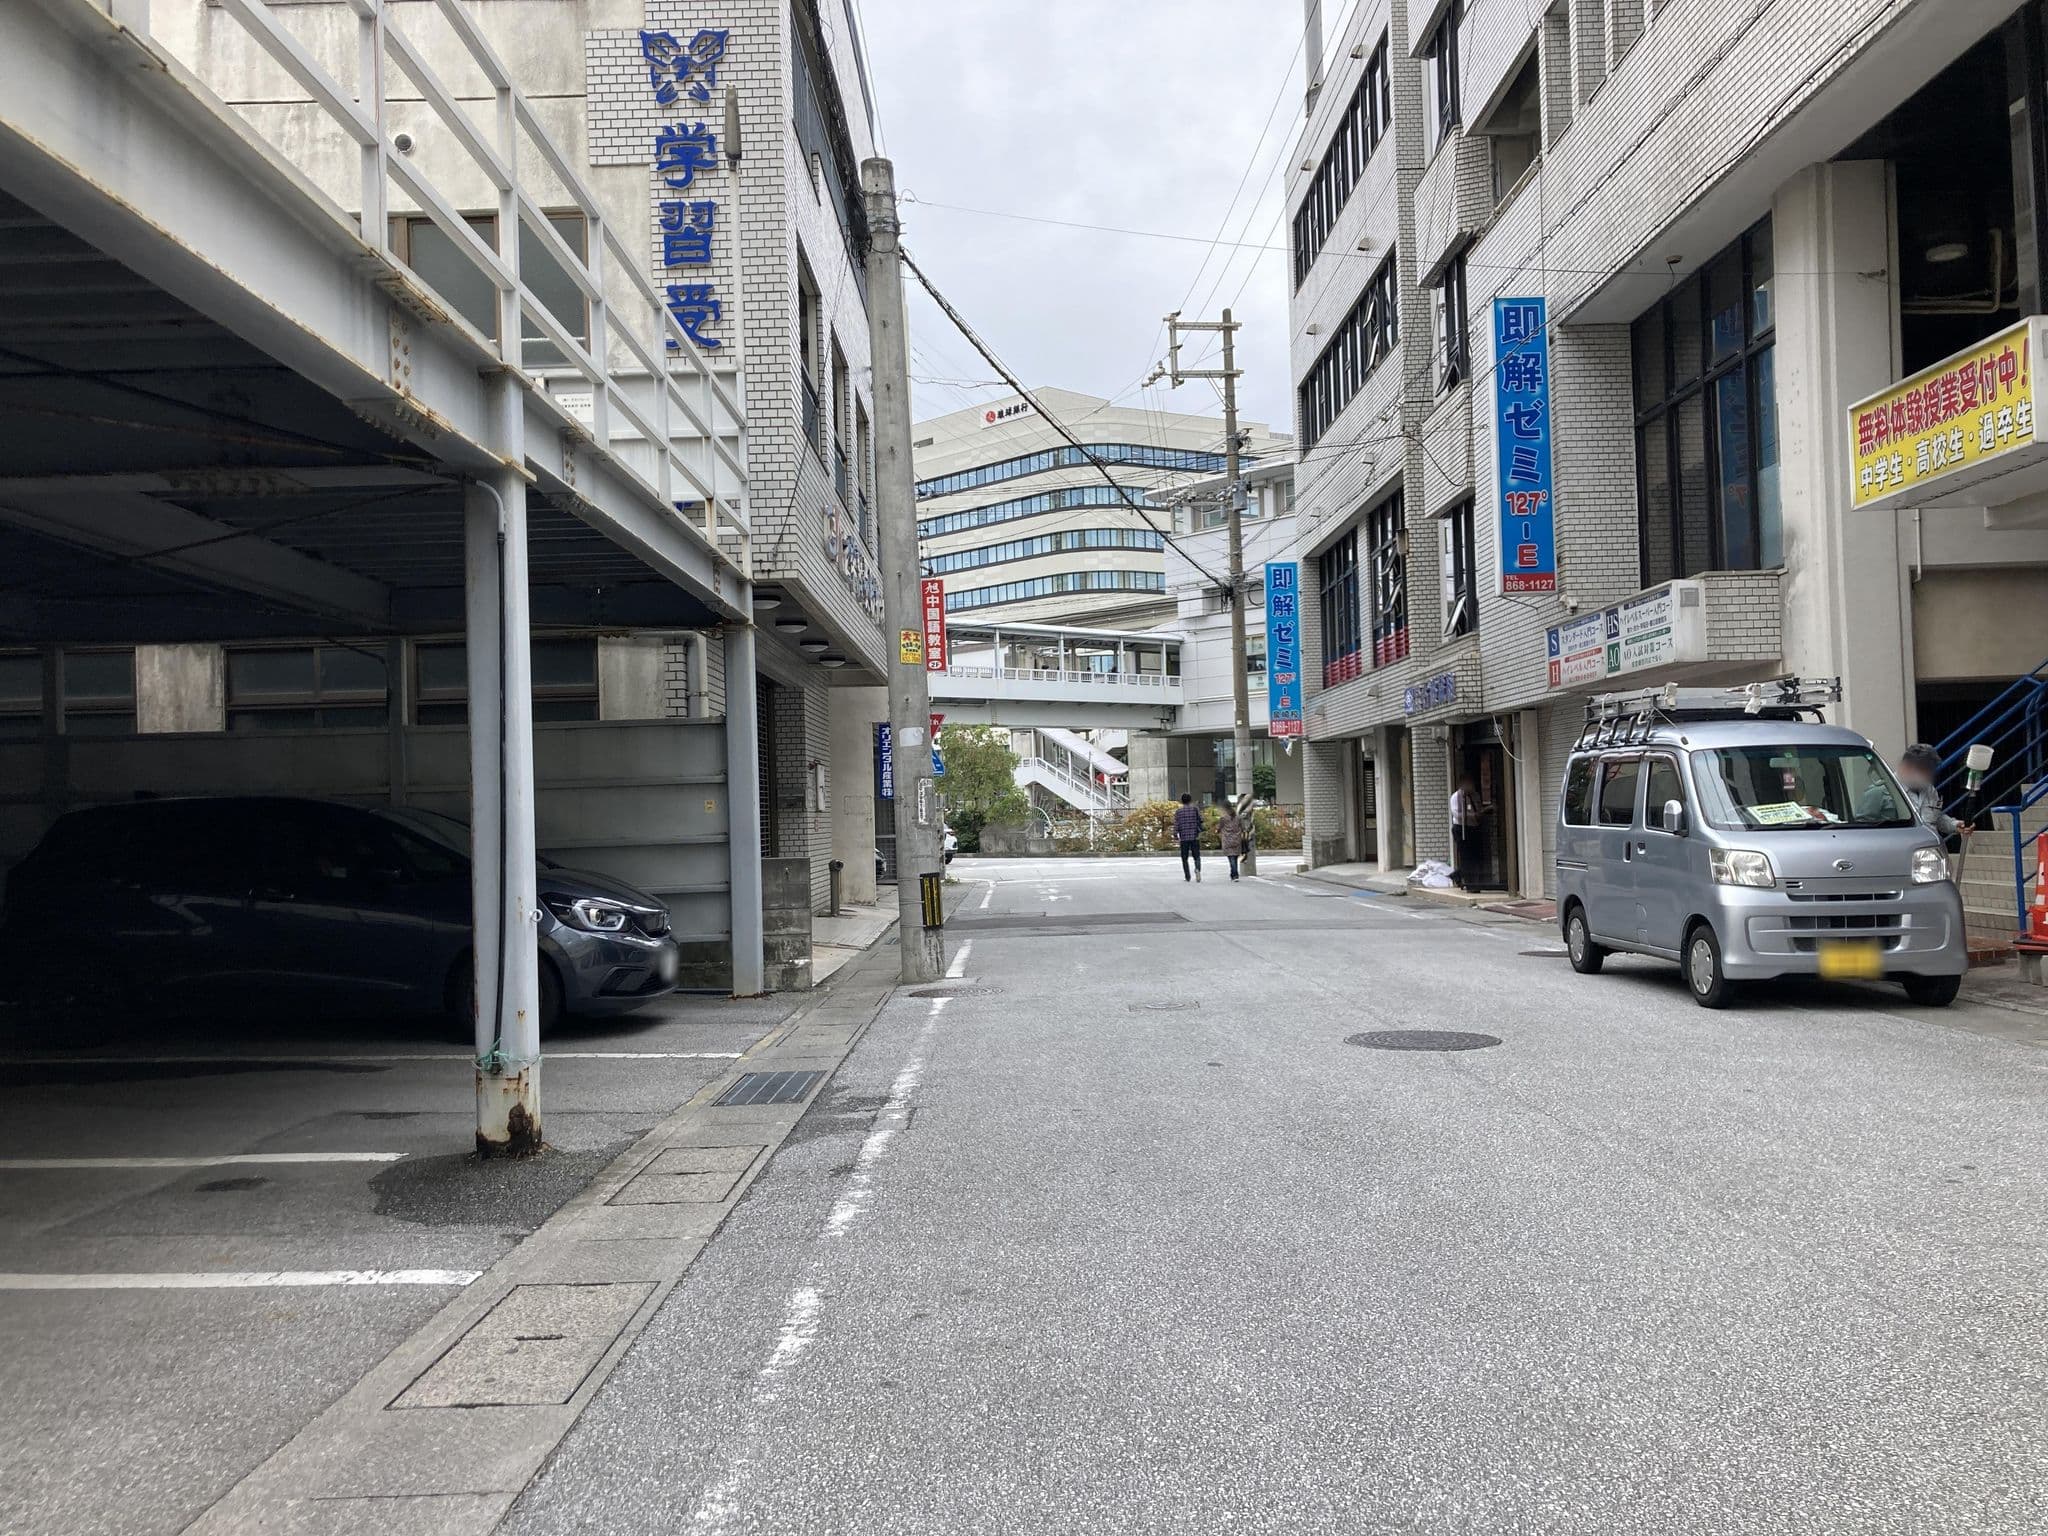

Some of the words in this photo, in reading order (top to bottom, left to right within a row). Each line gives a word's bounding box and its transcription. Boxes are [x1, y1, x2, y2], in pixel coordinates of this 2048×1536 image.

[1501, 305, 1543, 484] 即解ゼミ
[1505, 579, 1554, 591] 868-1127
[1272, 568, 1295, 669] 即解ゼミ
[1607, 613, 1619, 636] HS
[1551, 633, 1558, 652] S
[1607, 648, 1619, 669] AO
[1552, 664, 1559, 683] H
